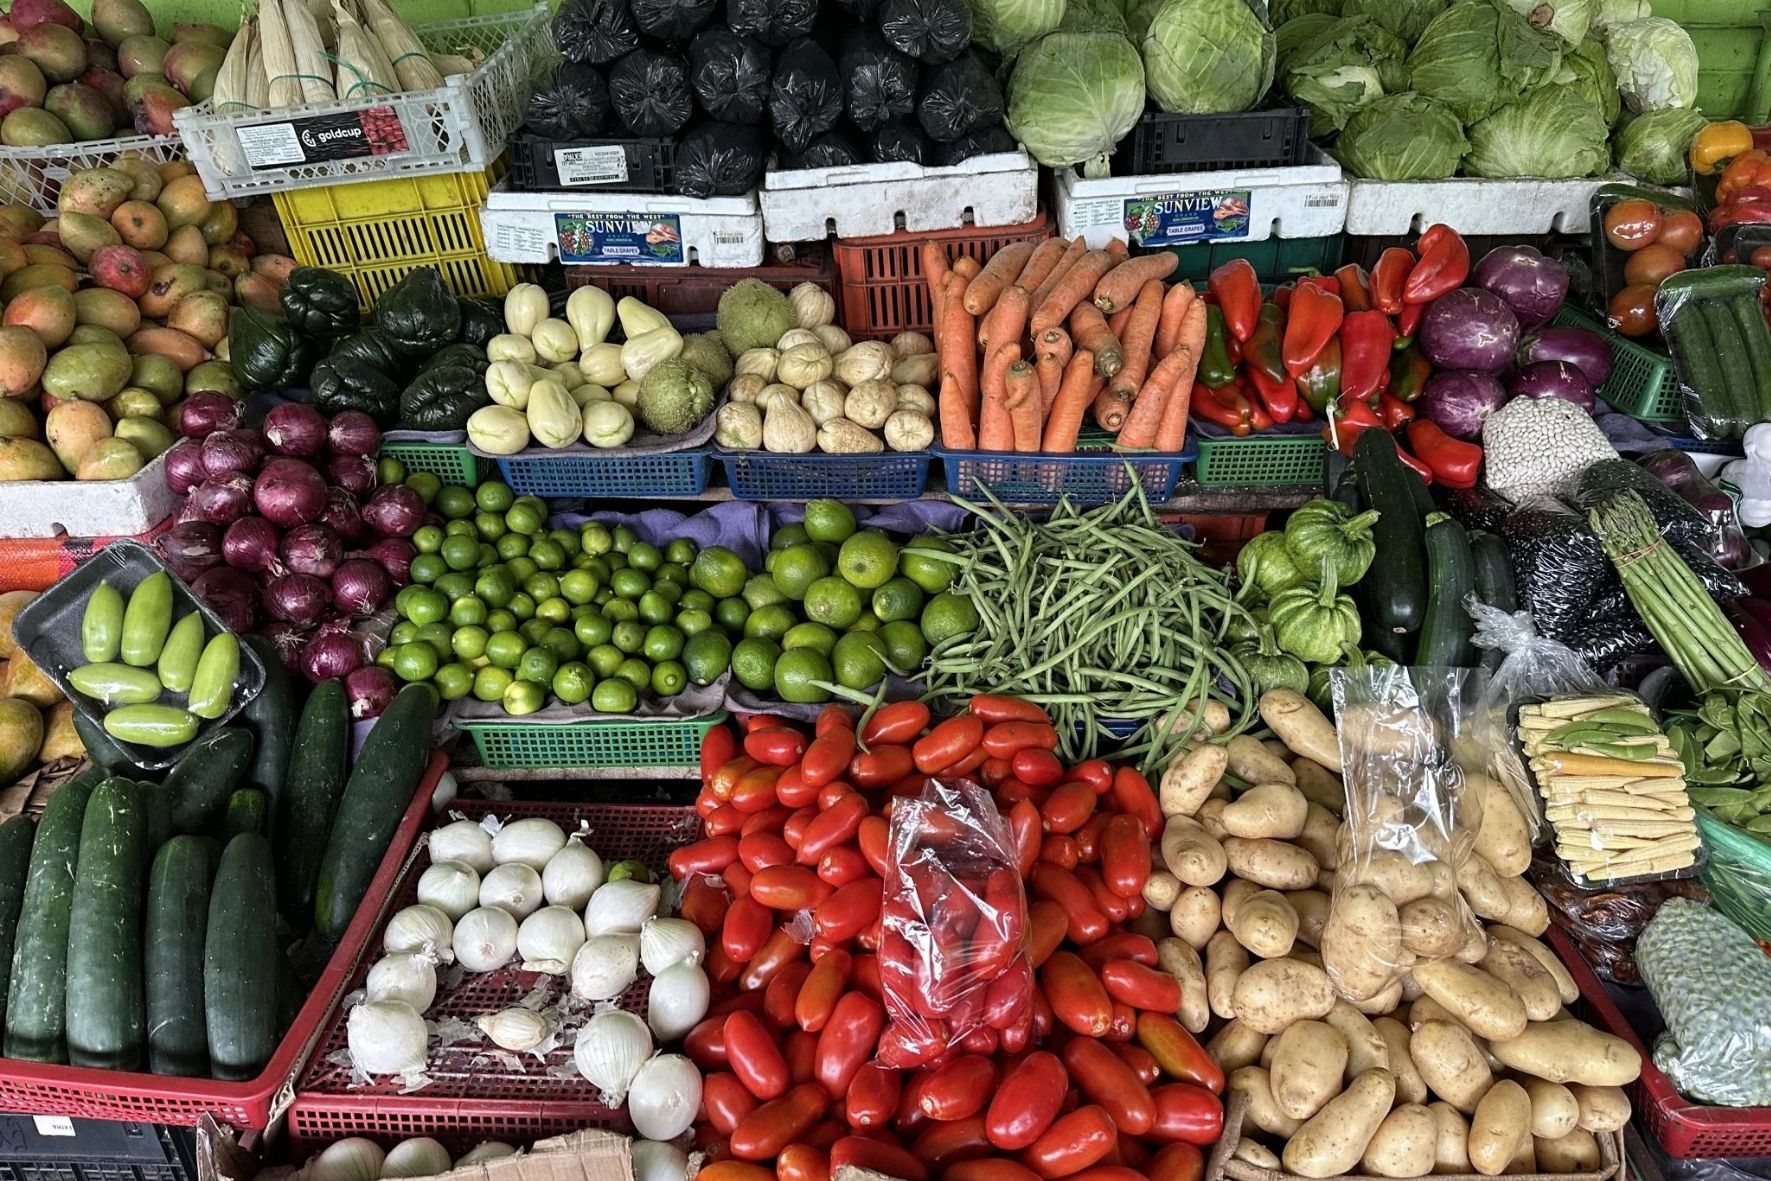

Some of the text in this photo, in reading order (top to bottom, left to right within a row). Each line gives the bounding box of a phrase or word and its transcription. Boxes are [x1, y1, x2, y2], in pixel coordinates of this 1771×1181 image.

[318, 128, 361, 142] goldcup
[1153, 196, 1223, 214] SUNVIEW
[585, 220, 653, 233] SUNVI
